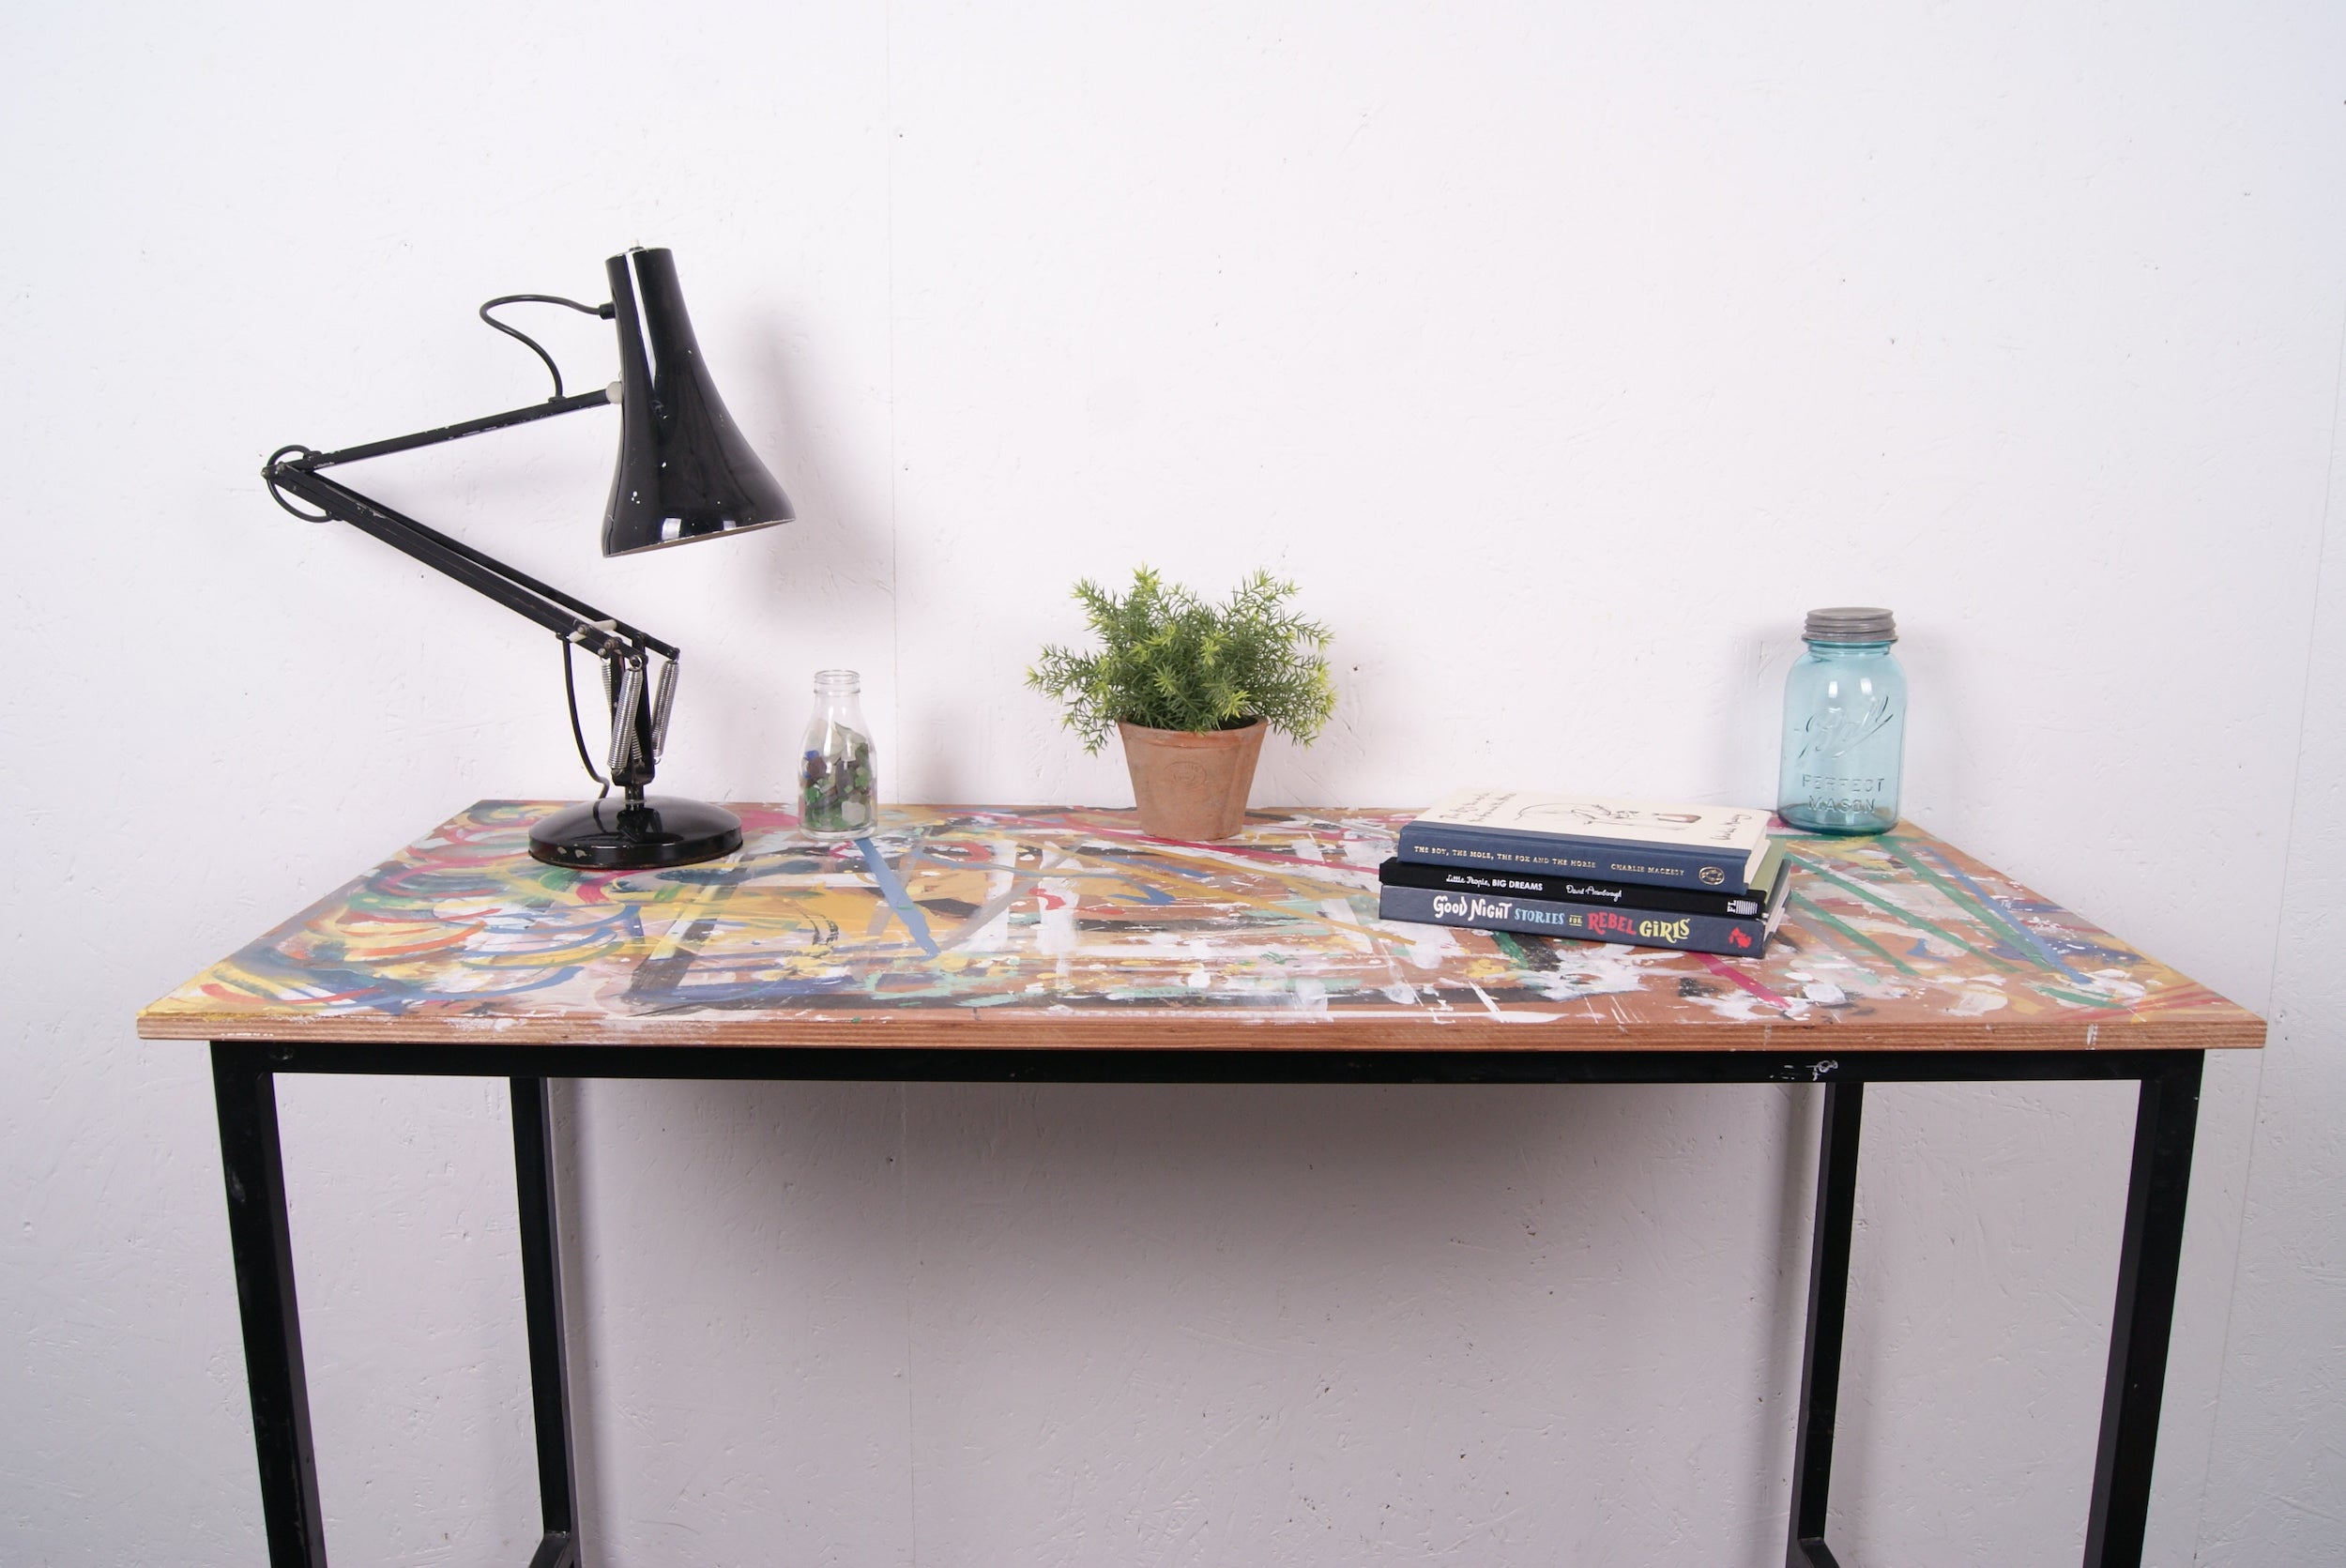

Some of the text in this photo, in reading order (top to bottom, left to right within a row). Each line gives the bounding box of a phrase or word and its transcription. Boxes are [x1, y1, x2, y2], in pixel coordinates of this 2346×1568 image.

[1802, 773, 1885, 792] PERFECT
[1808, 795, 1876, 814] MASON
[1452, 848, 1468, 857] THE
[1470, 849, 1494, 860] MOLE,
[1533, 856, 1549, 864] AND
[1552, 858, 1568, 866] THE
[1570, 860, 1596, 868] HORSE
[1610, 862, 1685, 876] CHARLIE MACKESY
[1446, 874, 1465, 883] Little
[1492, 878, 1507, 888] BIG
[1508, 880, 1544, 891] DREAMS
[1515, 907, 1565, 925] STORIES
[1569, 916, 1583, 925] FOR
[1587, 911, 1637, 936] REBEL
